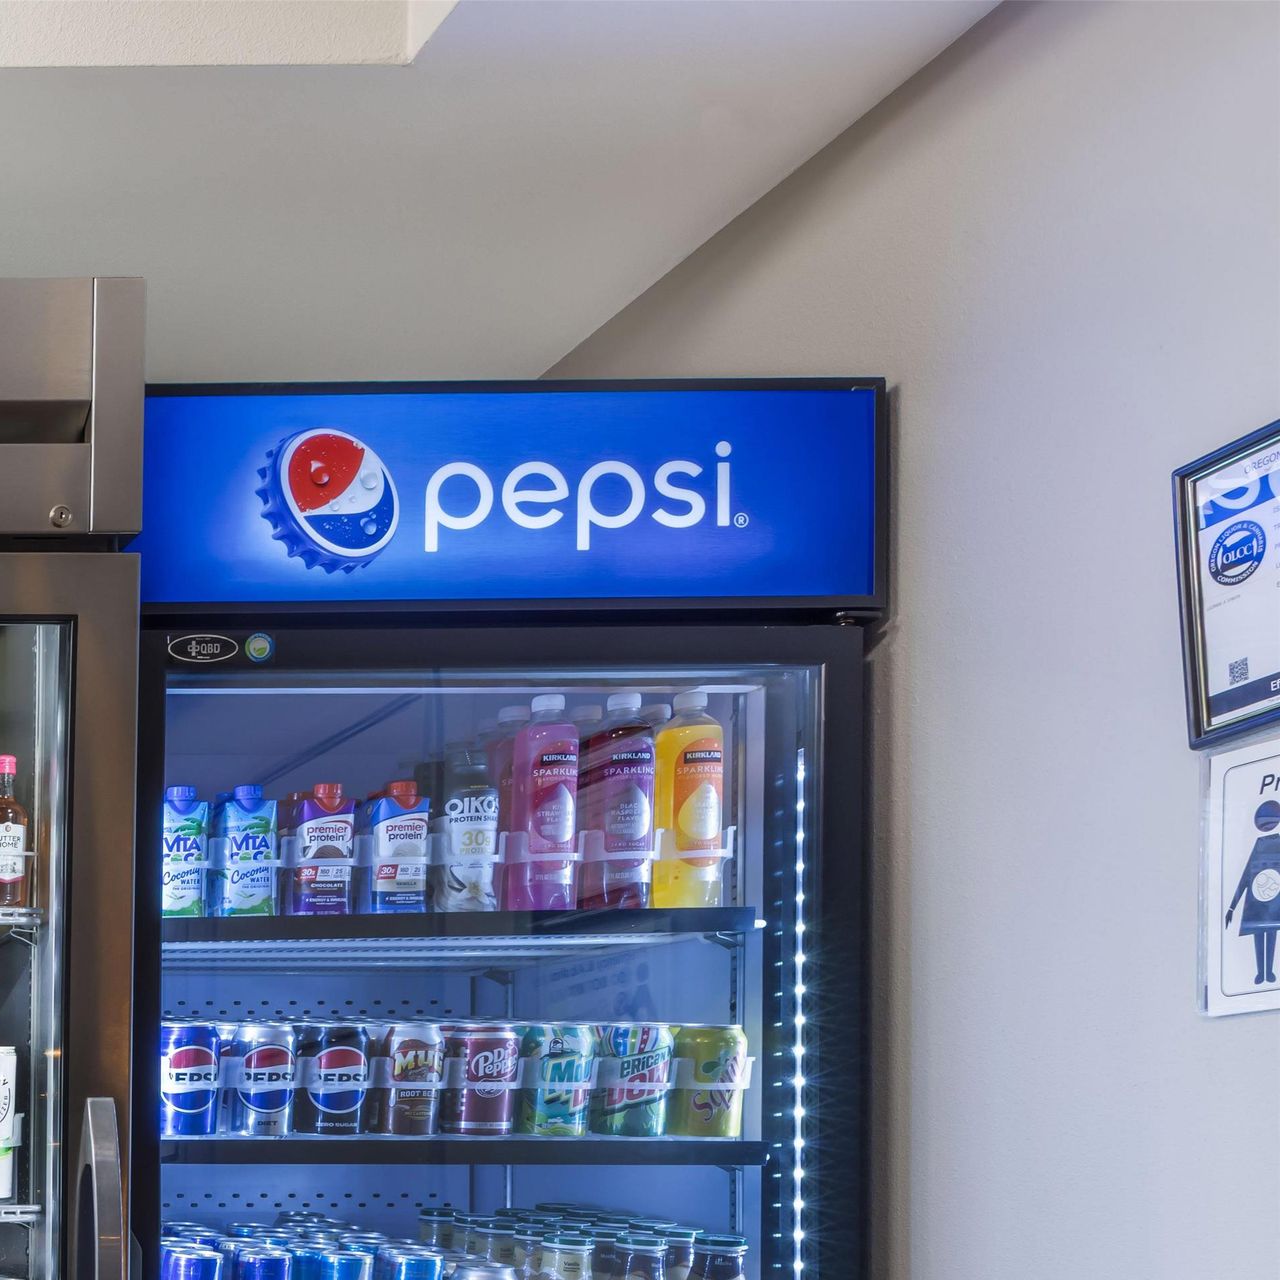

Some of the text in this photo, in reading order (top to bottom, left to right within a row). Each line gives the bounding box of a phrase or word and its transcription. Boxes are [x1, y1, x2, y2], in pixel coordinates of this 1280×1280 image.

[424, 440, 733, 553] pepsi
[1222, 543, 1253, 565] OLCC
[1217, 561, 1259, 585] COMMISSION
[542, 754, 578, 762] KIRKLAND
[612, 752, 651, 761] KIRKLAND
[686, 751, 721, 759] KIRKLAND
[449, 815, 482, 824] PROTEIN
[306, 824, 349, 836] premier
[385, 823, 425, 834] premier
[231, 833, 270, 851] VITA
[309, 833, 346, 844] protein
[388, 831, 423, 842] protein
[164, 833, 201, 853] VITA
[400, 1090, 421, 1098] ROOT
